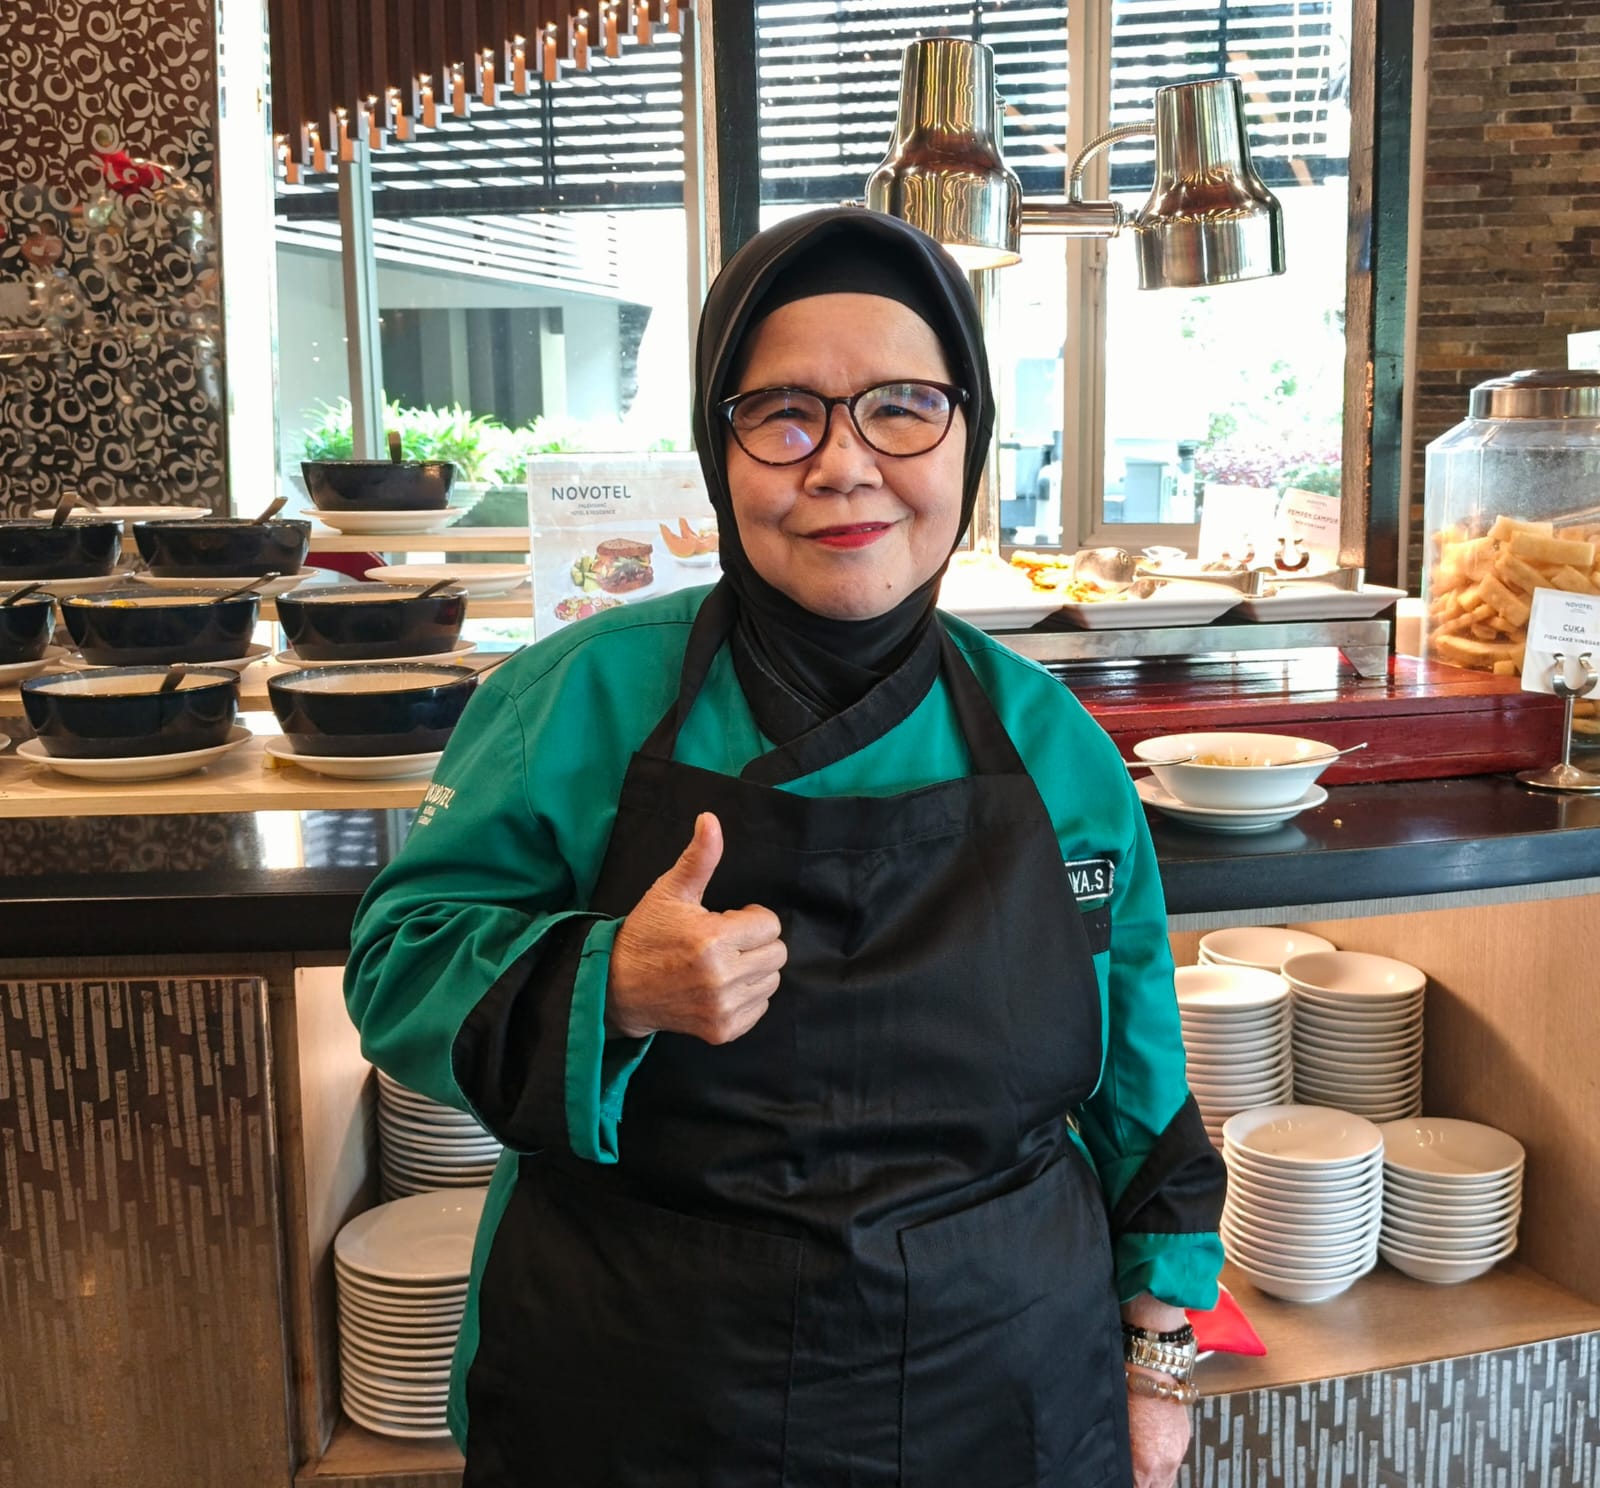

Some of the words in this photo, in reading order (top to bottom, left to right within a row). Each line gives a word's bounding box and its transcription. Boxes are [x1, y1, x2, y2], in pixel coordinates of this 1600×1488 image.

[551, 485, 631, 500] NOVOTEL
[1562, 623, 1585, 633] CUKA
[1558, 635, 1573, 643] CAKE
